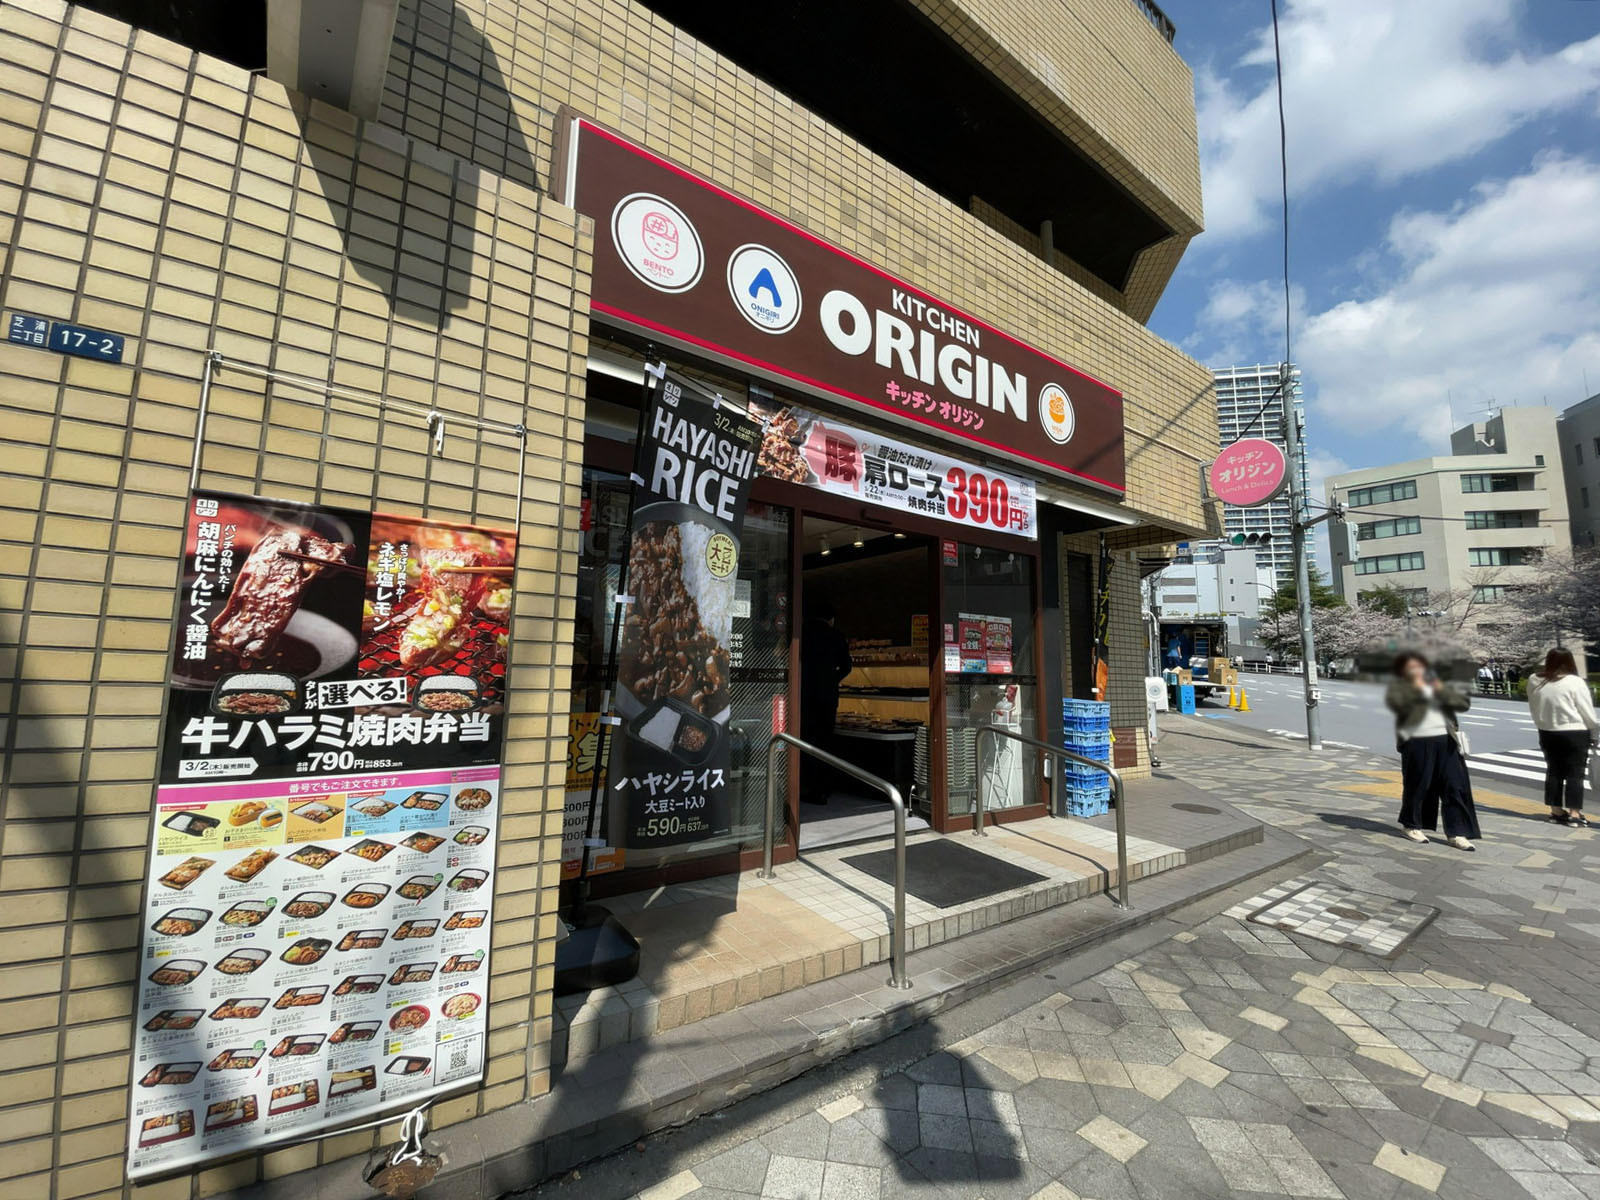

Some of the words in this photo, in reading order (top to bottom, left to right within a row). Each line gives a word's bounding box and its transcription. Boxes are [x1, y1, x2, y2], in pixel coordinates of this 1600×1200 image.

[643, 257, 674, 277] BENTO
[13, 316, 46, 331] 芝浦
[751, 302, 780, 320] ONIGIRI
[892, 288, 980, 349] KITCHEN
[11, 329, 44, 344] 二丁目
[61, 330, 114, 354] 17-2
[820, 290, 1028, 422] ORIGIN
[886, 380, 936, 414] キッチン
[939, 402, 985, 431] オリジン
[652, 406, 755, 480] HAYASHI
[824, 435, 858, 481] 豚
[878, 444, 933, 471] 醤油だれ漬け
[1227, 450, 1264, 465] キッチン
[651, 447, 739, 522] RICE
[863, 454, 946, 502] 肩ロース
[1219, 461, 1276, 483] オリジン
[908, 495, 945, 515] 焼肉弁当
[183, 521, 221, 660] 胡麻にんにく醤油
[373, 541, 396, 632] ネギ塩レモン
[304, 680, 318, 710] タレが
[321, 678, 406, 707] 選べる!
[181, 711, 492, 755] 牛ハラミ焼肉弁当
[307, 751, 364, 772] 790円
[289, 777, 402, 794] 番号でもご注文できます。
[614, 768, 725, 796] ハヤシライス
[645, 795, 705, 814] 大豆ミート入り
[647, 816, 687, 837] 590円
